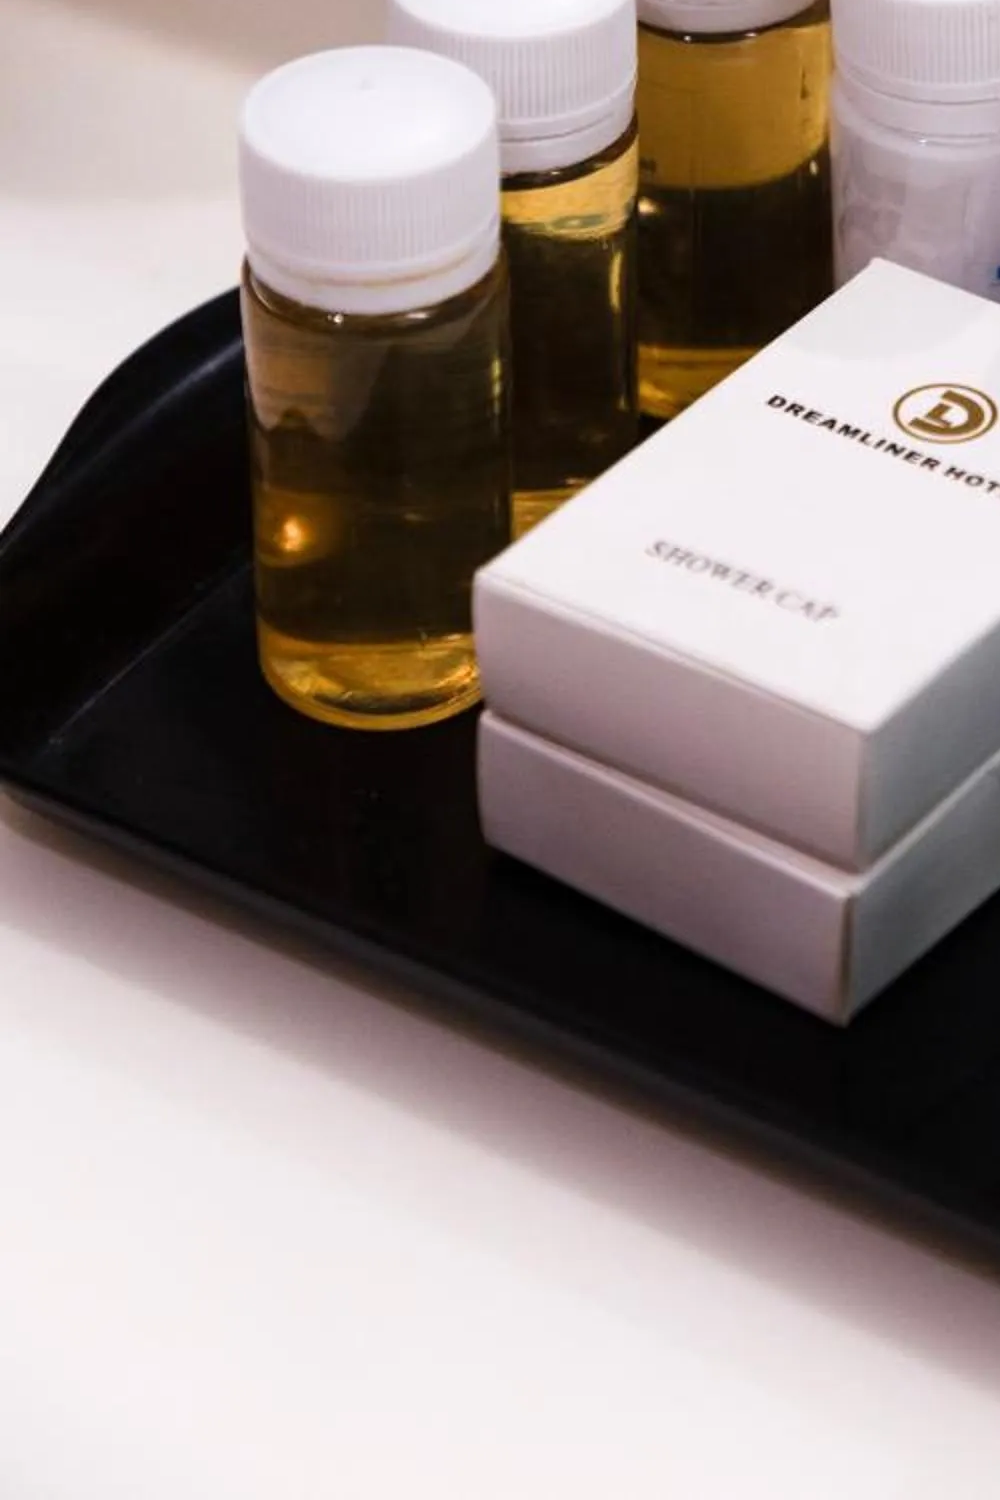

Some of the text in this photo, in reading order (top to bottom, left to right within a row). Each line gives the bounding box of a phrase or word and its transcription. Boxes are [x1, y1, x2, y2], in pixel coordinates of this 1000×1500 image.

[766, 394, 941, 471] DREAMLINER
[644, 540, 841, 623] SHOWER CAP
